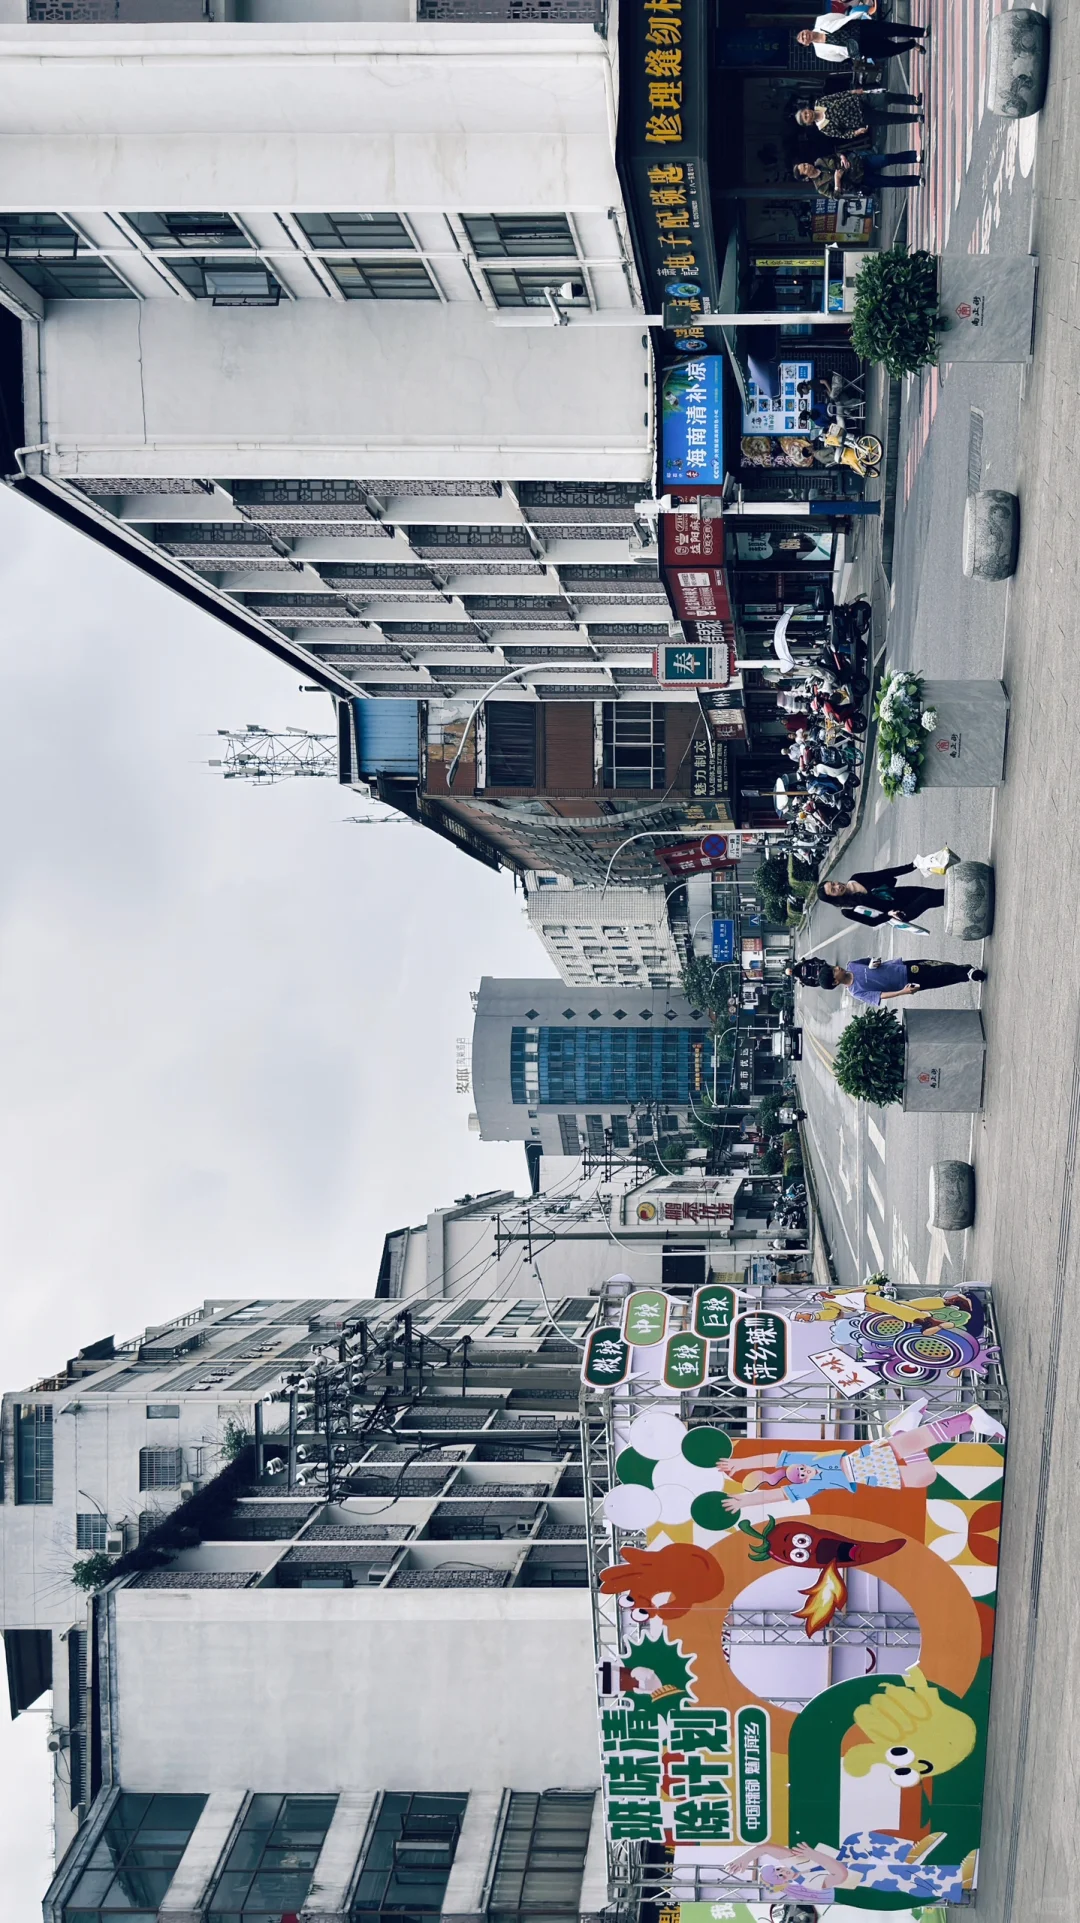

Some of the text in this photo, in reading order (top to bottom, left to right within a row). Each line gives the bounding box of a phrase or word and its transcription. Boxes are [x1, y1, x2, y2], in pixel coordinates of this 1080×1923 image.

[647, 165, 695, 268] 电子配锁匙
[971, 296, 981, 326] 南正街
[685, 362, 707, 468] 海南清补凉
[694, 740, 706, 796] 魅力制衣
[630, 1302, 661, 1334] 中辣
[702, 1296, 730, 1327] 巨辣
[592, 1339, 624, 1373] 微辣
[671, 1343, 700, 1376] 重辣
[602, 1710, 663, 1840] 班味清
[670, 1710, 730, 1839] 除计划
[744, 1722, 761, 1829] 中国辣都 魅力萍乡
